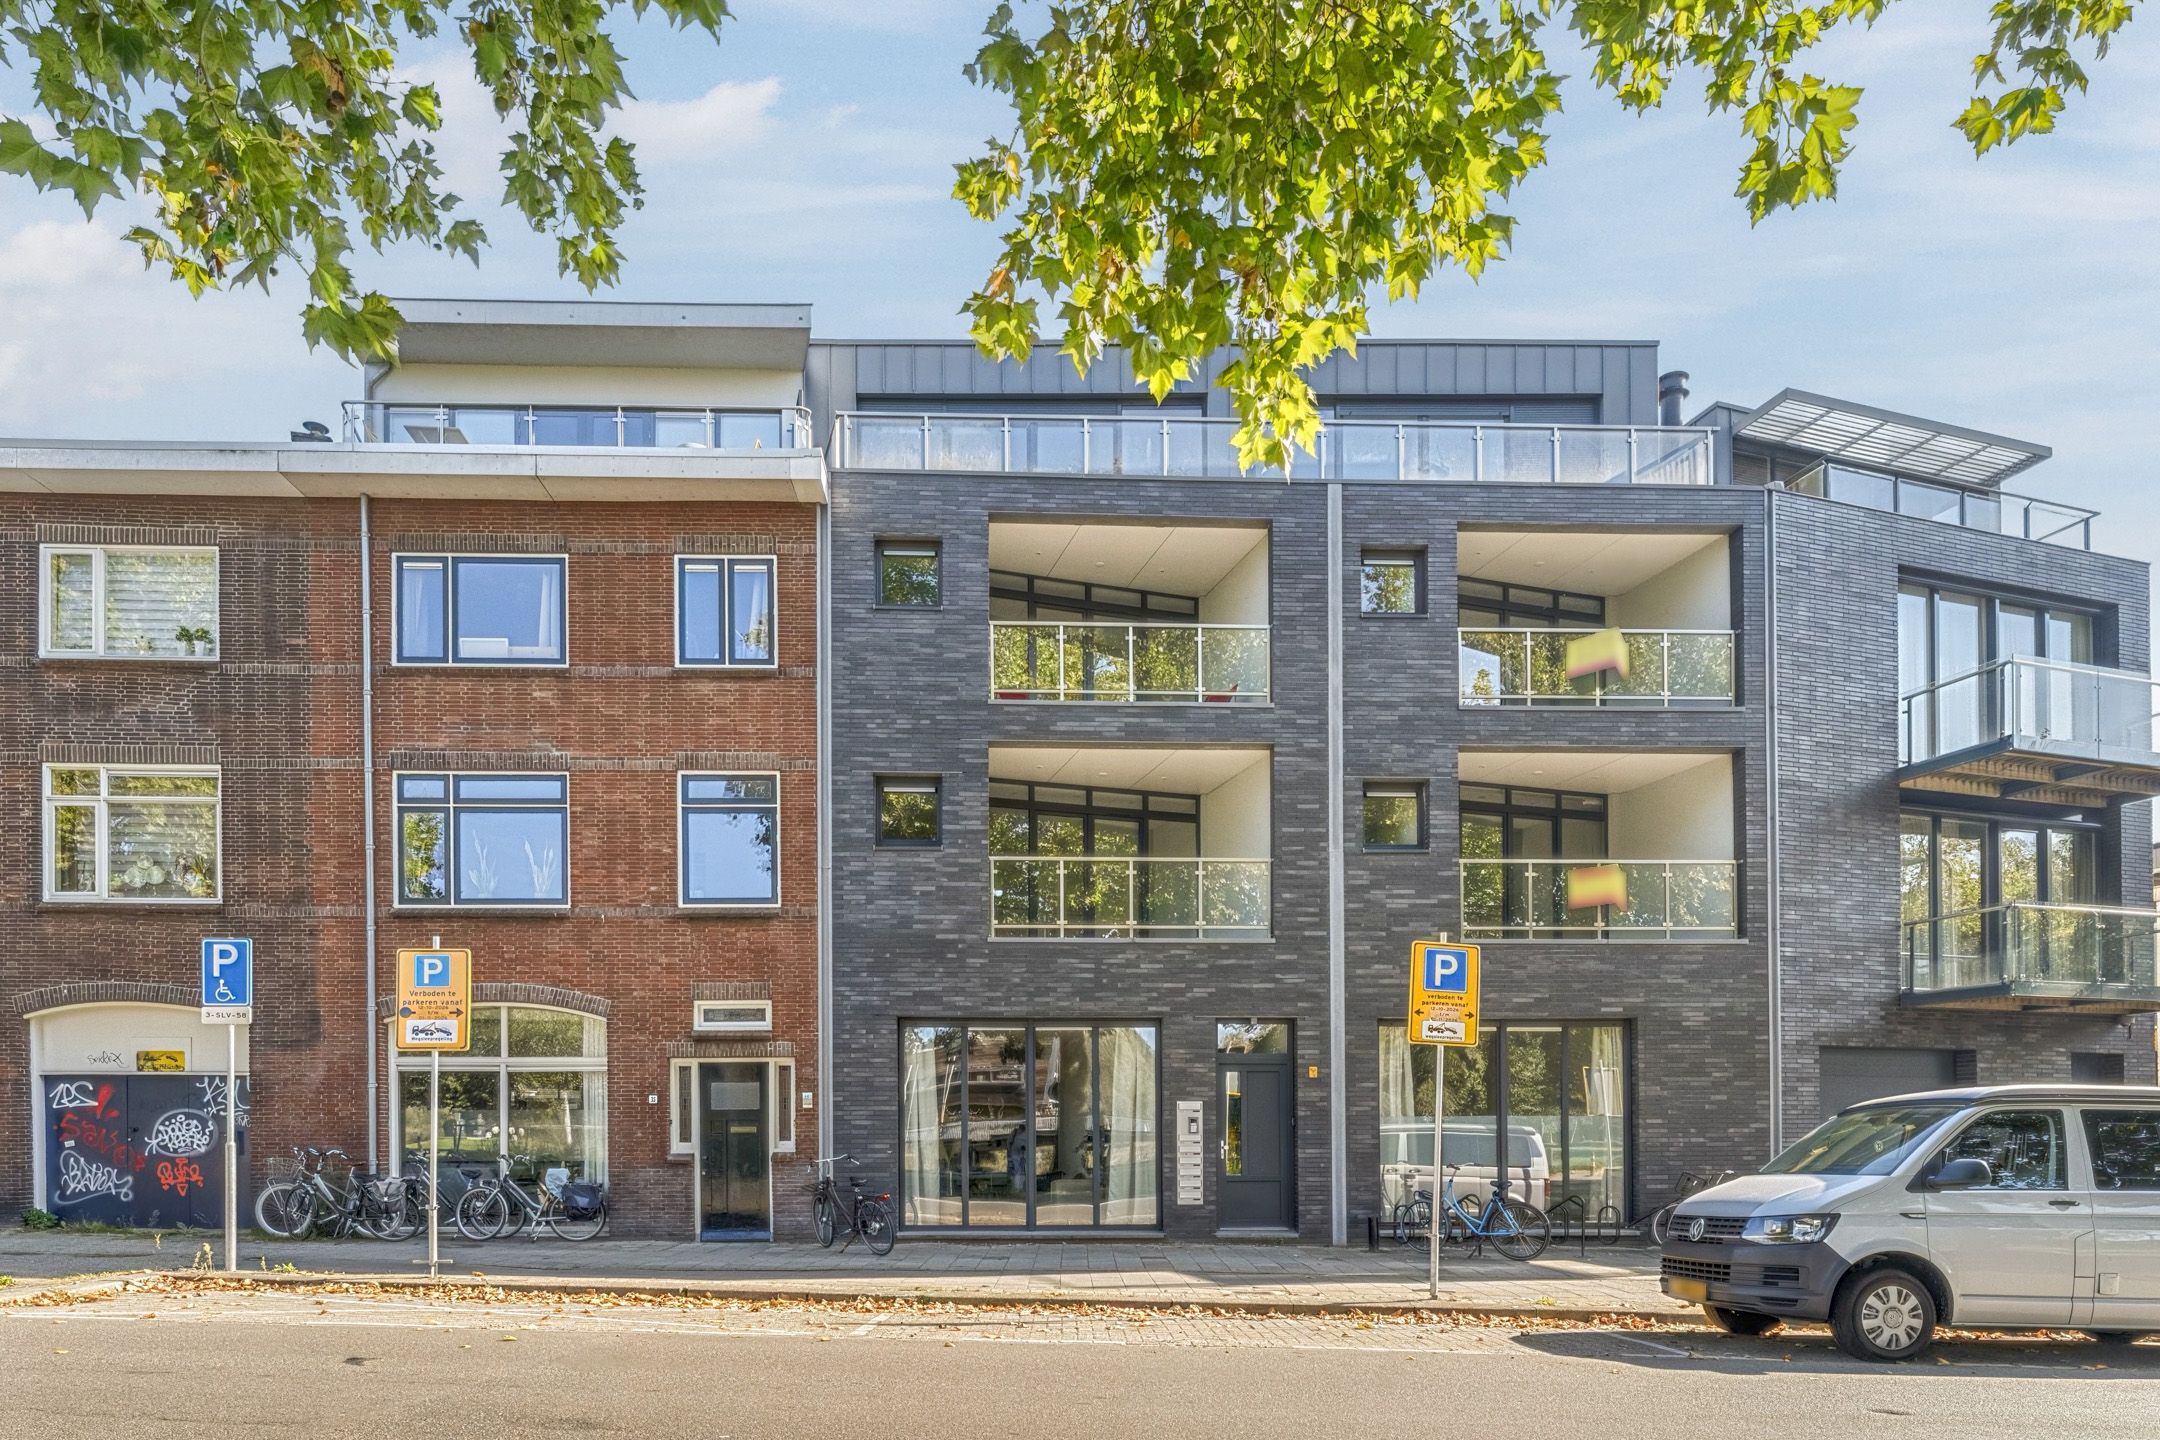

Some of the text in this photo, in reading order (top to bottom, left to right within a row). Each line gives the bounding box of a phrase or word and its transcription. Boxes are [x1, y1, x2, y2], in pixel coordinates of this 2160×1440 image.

[213, 944, 238, 977] P
[423, 958, 443, 984] P
[1434, 954, 1458, 987] P
[1427, 993, 1456, 1001] verboden
